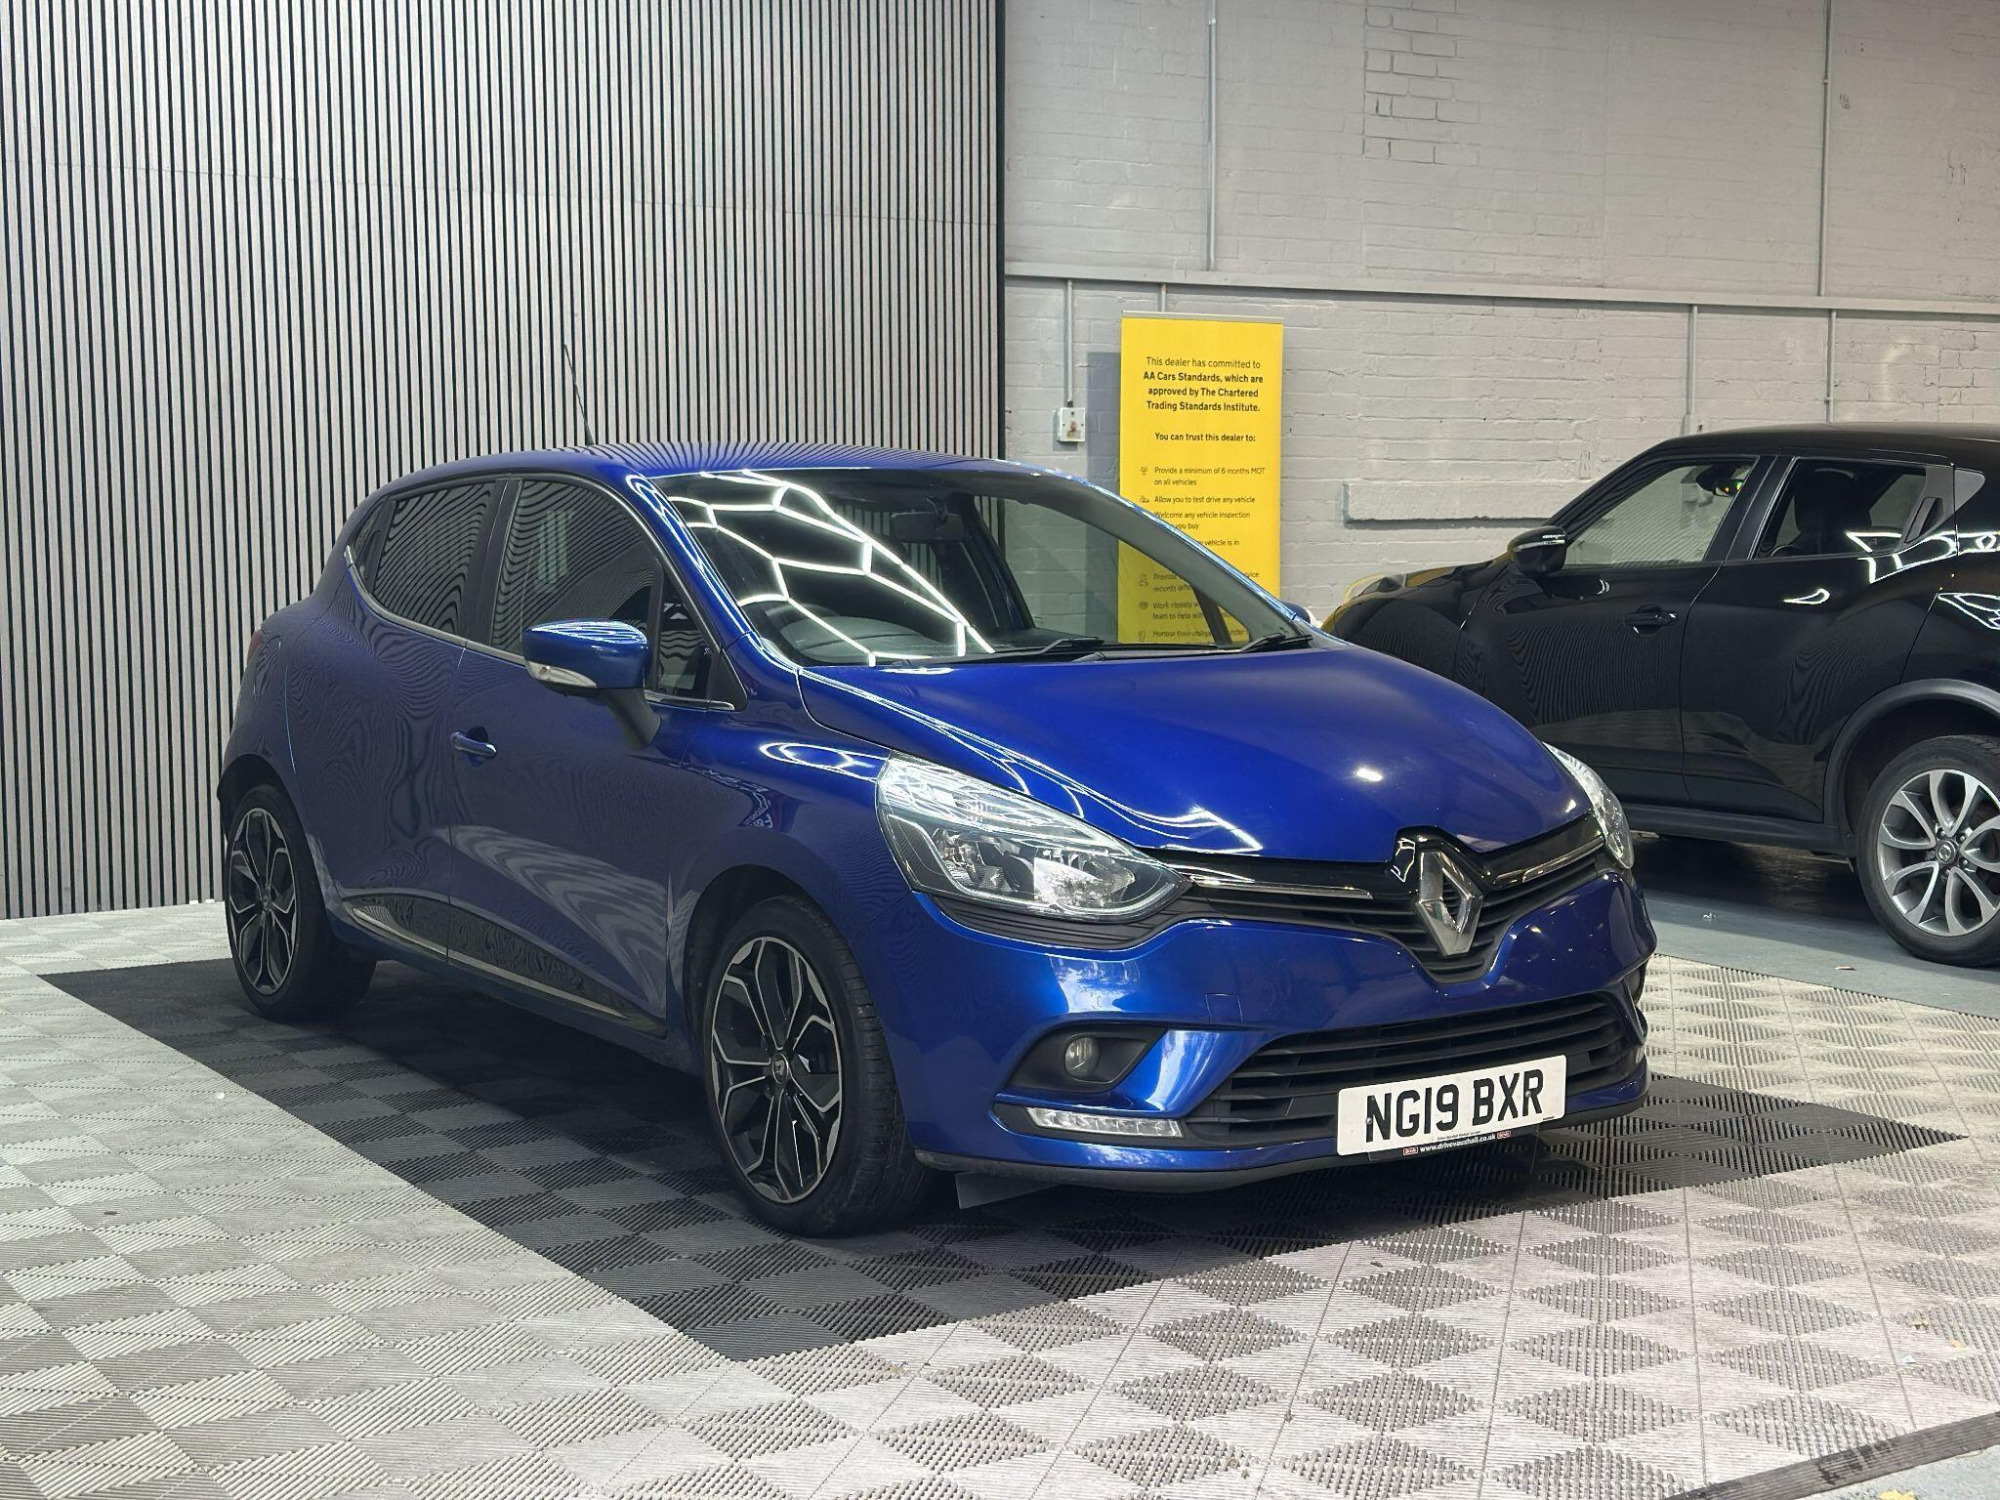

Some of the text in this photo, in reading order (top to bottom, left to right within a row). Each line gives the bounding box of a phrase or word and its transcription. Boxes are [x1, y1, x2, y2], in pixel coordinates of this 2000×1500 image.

[1147, 357, 1260, 369] This dealer has committed to
[1143, 371, 1155, 380] AA
[1157, 372, 1176, 381] Cars
[1178, 372, 1222, 383] Standards,
[1224, 374, 1248, 383] which
[1148, 387, 1258, 397] approved by The Chartered
[1147, 401, 1260, 412] Trading Standards Institute.
[1155, 432, 1168, 440] You
[1186, 433, 1203, 441] trust
[1205, 433, 1219, 441] this
[1221, 433, 1243, 441] dealer
[1245, 434, 1256, 442] to:
[1155, 466, 1177, 474] Provide
[1184, 512, 1195, 520] any
[1220, 511, 1250, 520] inspection
[1188, 522, 1199, 530] buy
[1365, 1068, 1544, 1144] NG19 BXR
[1420, 1133, 1496, 1153] www.drivevauxhall.co.uk
